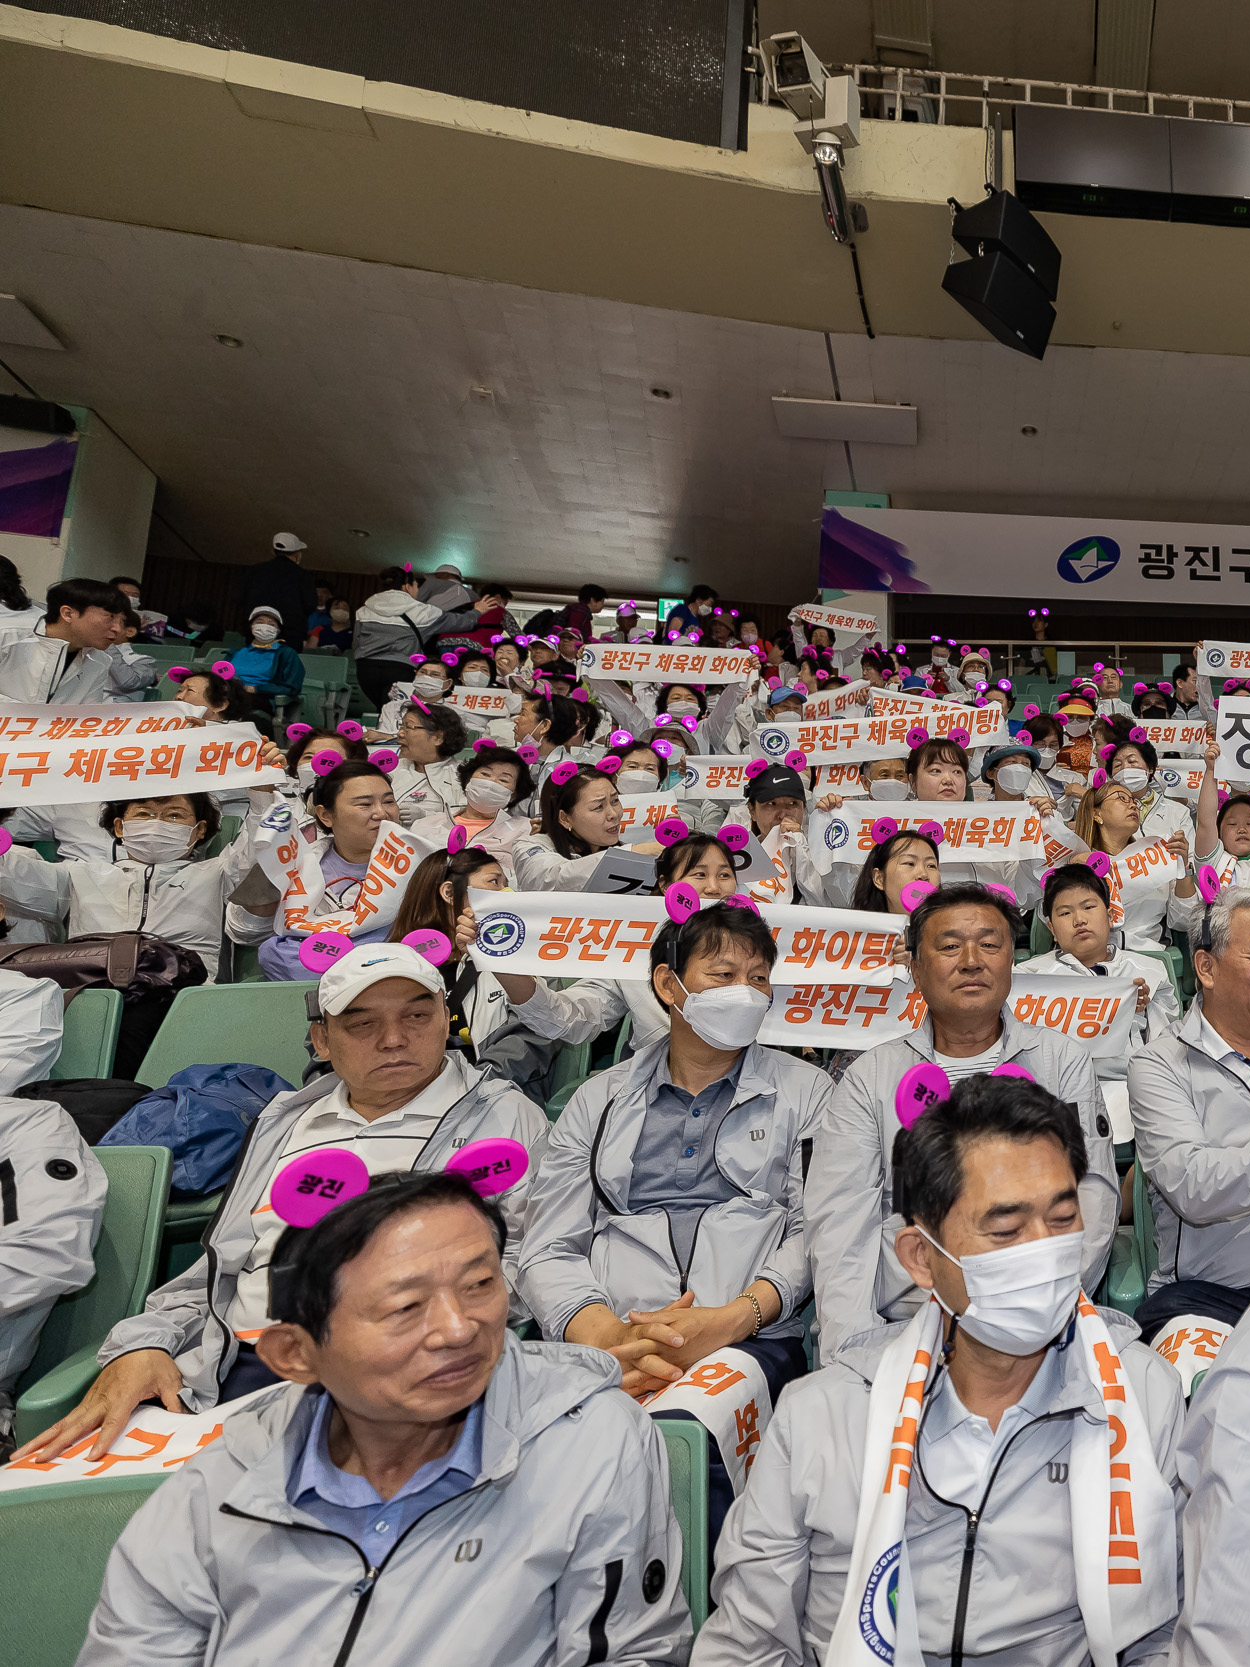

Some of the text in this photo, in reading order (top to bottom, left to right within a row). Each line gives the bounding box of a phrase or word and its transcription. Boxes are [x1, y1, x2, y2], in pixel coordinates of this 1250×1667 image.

[825, 613, 855, 629] 체육회
[600, 650, 651, 672] 광진구
[658, 653, 707, 674] 체육회
[0, 717, 38, 741] 구
[38, 716, 131, 740] 체육회
[796, 722, 860, 754] 광진구
[935, 709, 1001, 737] 화이팅!
[0, 751, 51, 788] 구
[64, 743, 188, 784] 체육회
[664, 827, 681, 839] 광진
[941, 816, 1016, 849] 체육회
[676, 893, 693, 910] 광진
[313, 940, 340, 957] 광진
[538, 916, 659, 964] 광진구
[784, 984, 893, 1028] 광진구
[1014, 993, 1122, 1040] 화이팅!
[915, 1083, 939, 1103] 광진
[468, 1157, 512, 1183] 광진
[295, 1173, 344, 1200] 광진
